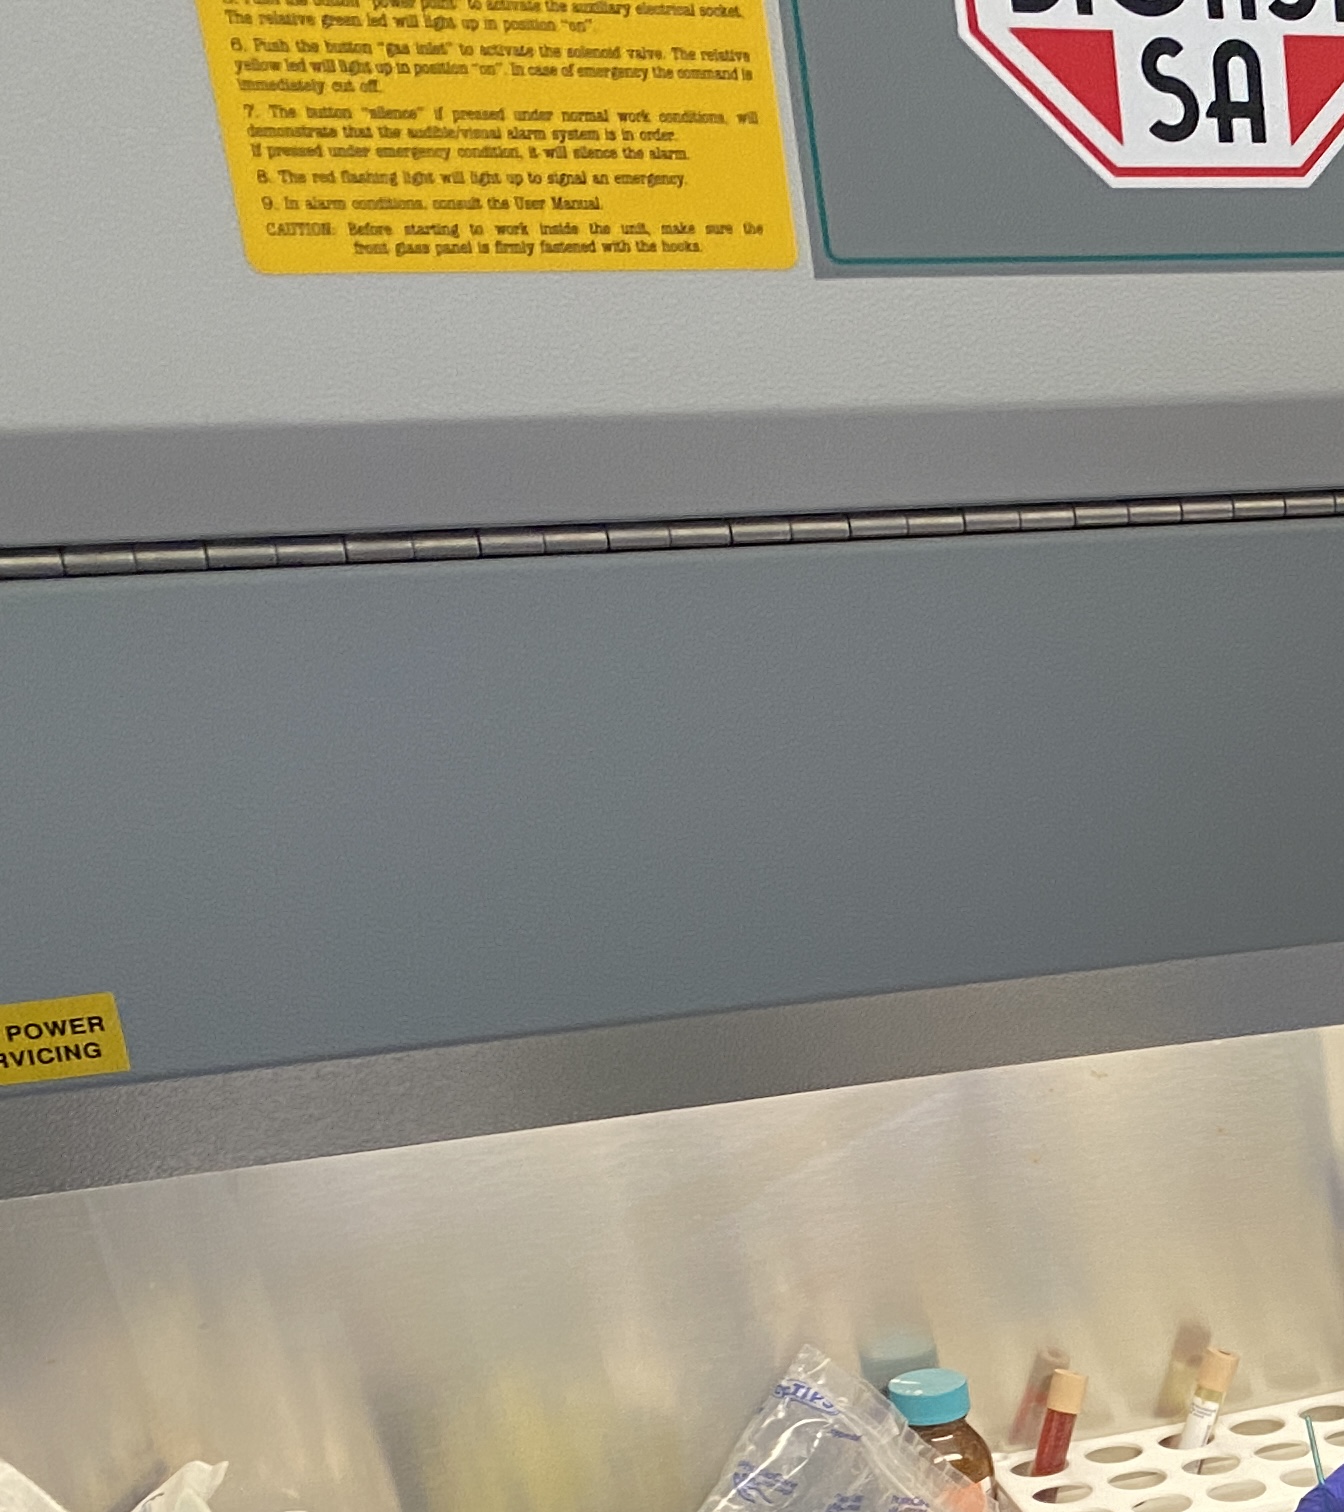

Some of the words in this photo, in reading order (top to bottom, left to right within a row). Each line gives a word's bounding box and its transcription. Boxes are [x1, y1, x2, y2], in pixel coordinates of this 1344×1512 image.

[225, 9, 252, 25] The
[461, 18, 479, 32] up
[484, 18, 497, 30] in
[253, 38, 289, 52] Push
[296, 39, 319, 53] the
[459, 43, 474, 56] to
[539, 45, 561, 58] the
[671, 46, 696, 60] The
[235, 60, 281, 75] yellow
[375, 63, 392, 76] up
[397, 62, 410, 74] in
[528, 66, 557, 77] case
[561, 63, 575, 77] of
[652, 66, 674, 79] the
[1141, 37, 1267, 143] SA
[269, 104, 296, 118] The
[514, 108, 553, 121] under
[562, 109, 608, 122] normal
[617, 109, 650, 122] work
[342, 125, 372, 139] that
[378, 126, 400, 139] the
[507, 128, 546, 140] alarm
[552, 129, 599, 143] system
[605, 128, 616, 140] is
[621, 128, 634, 140] in
[328, 146, 370, 158] under
[622, 147, 643, 159] the
[278, 170, 306, 183] The
[312, 170, 336, 184] red
[403, 170, 434, 186] light
[470, 171, 501, 187] light
[506, 174, 523, 187] up
[528, 172, 542, 184] to
[548, 172, 587, 187] signal
[592, 174, 609, 184] an
[284, 197, 299, 210] In
[305, 199, 346, 210] alarm
[488, 197, 509, 210] the
[514, 197, 545, 209] User
[348, 222, 392, 236] Before
[405, 224, 458, 238] starting
[469, 224, 484, 235] to
[495, 223, 528, 235] work
[539, 222, 578, 235] inside
[589, 222, 610, 235] the
[661, 223, 695, 235] make
[705, 224, 733, 235] sure
[743, 222, 764, 235] the
[435, 242, 471, 256] panel
[495, 241, 534, 256] firmly
[602, 241, 630, 253] with
[636, 241, 656, 253] the
[5, 1016, 105, 1042] POWER
